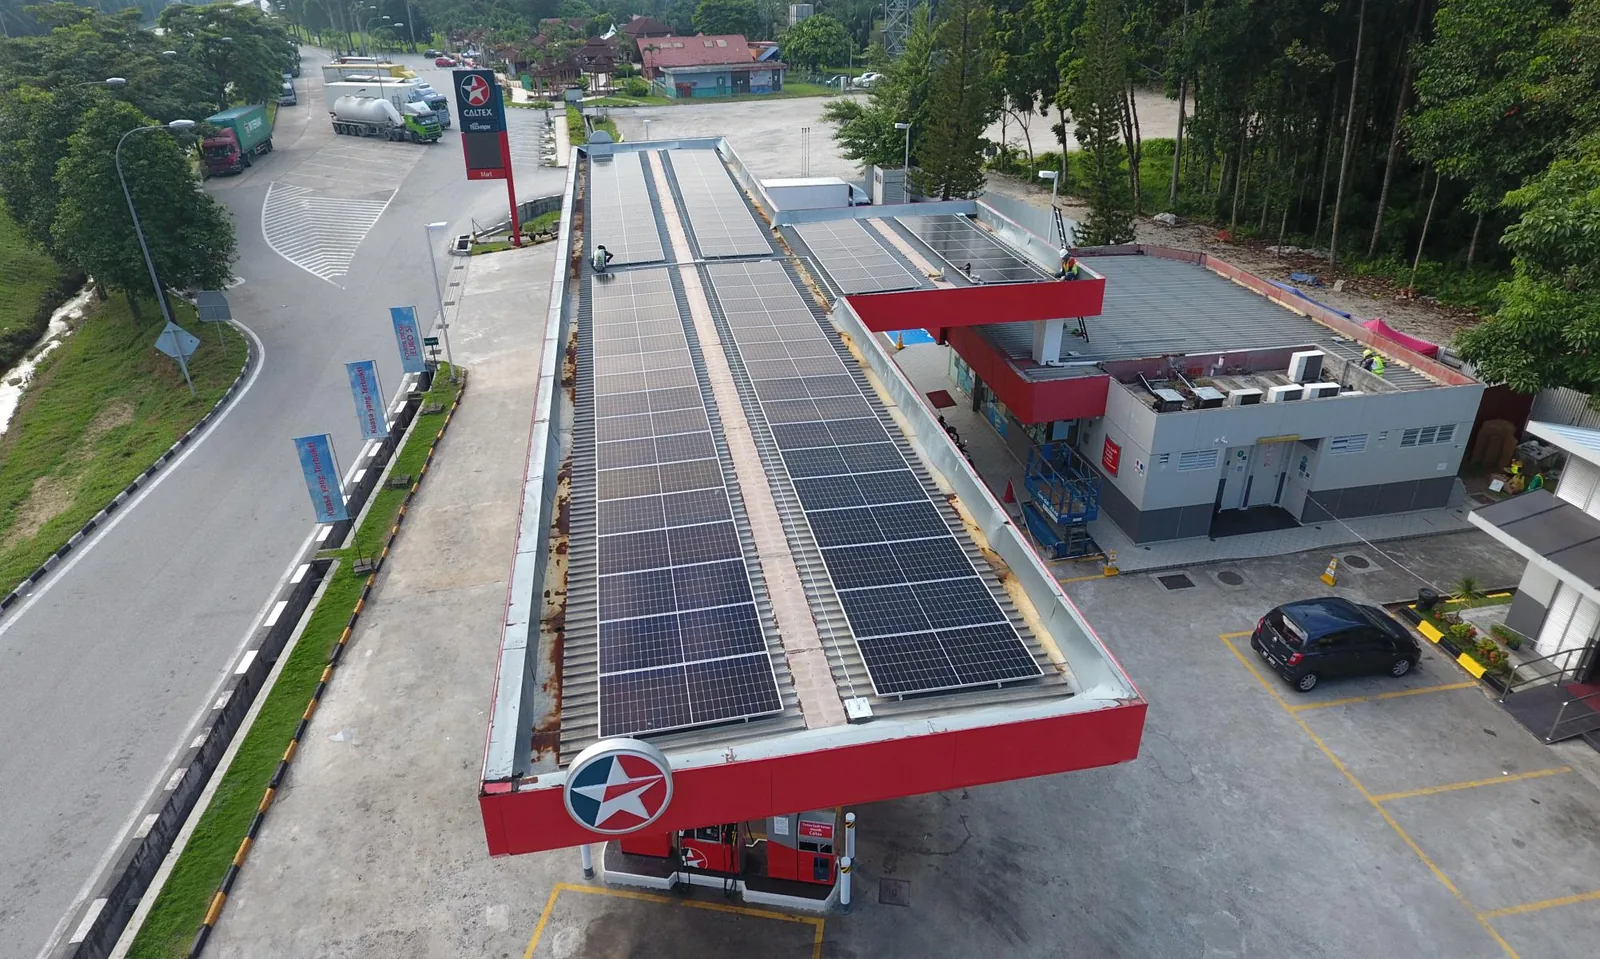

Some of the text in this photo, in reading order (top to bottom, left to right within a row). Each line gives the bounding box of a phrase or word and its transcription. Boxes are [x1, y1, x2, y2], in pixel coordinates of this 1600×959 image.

[464, 109, 492, 117] CALTEX
[356, 367, 377, 434] Kuasa yang Terbukti
[307, 442, 335, 516] Kuasa yang Terbukti
